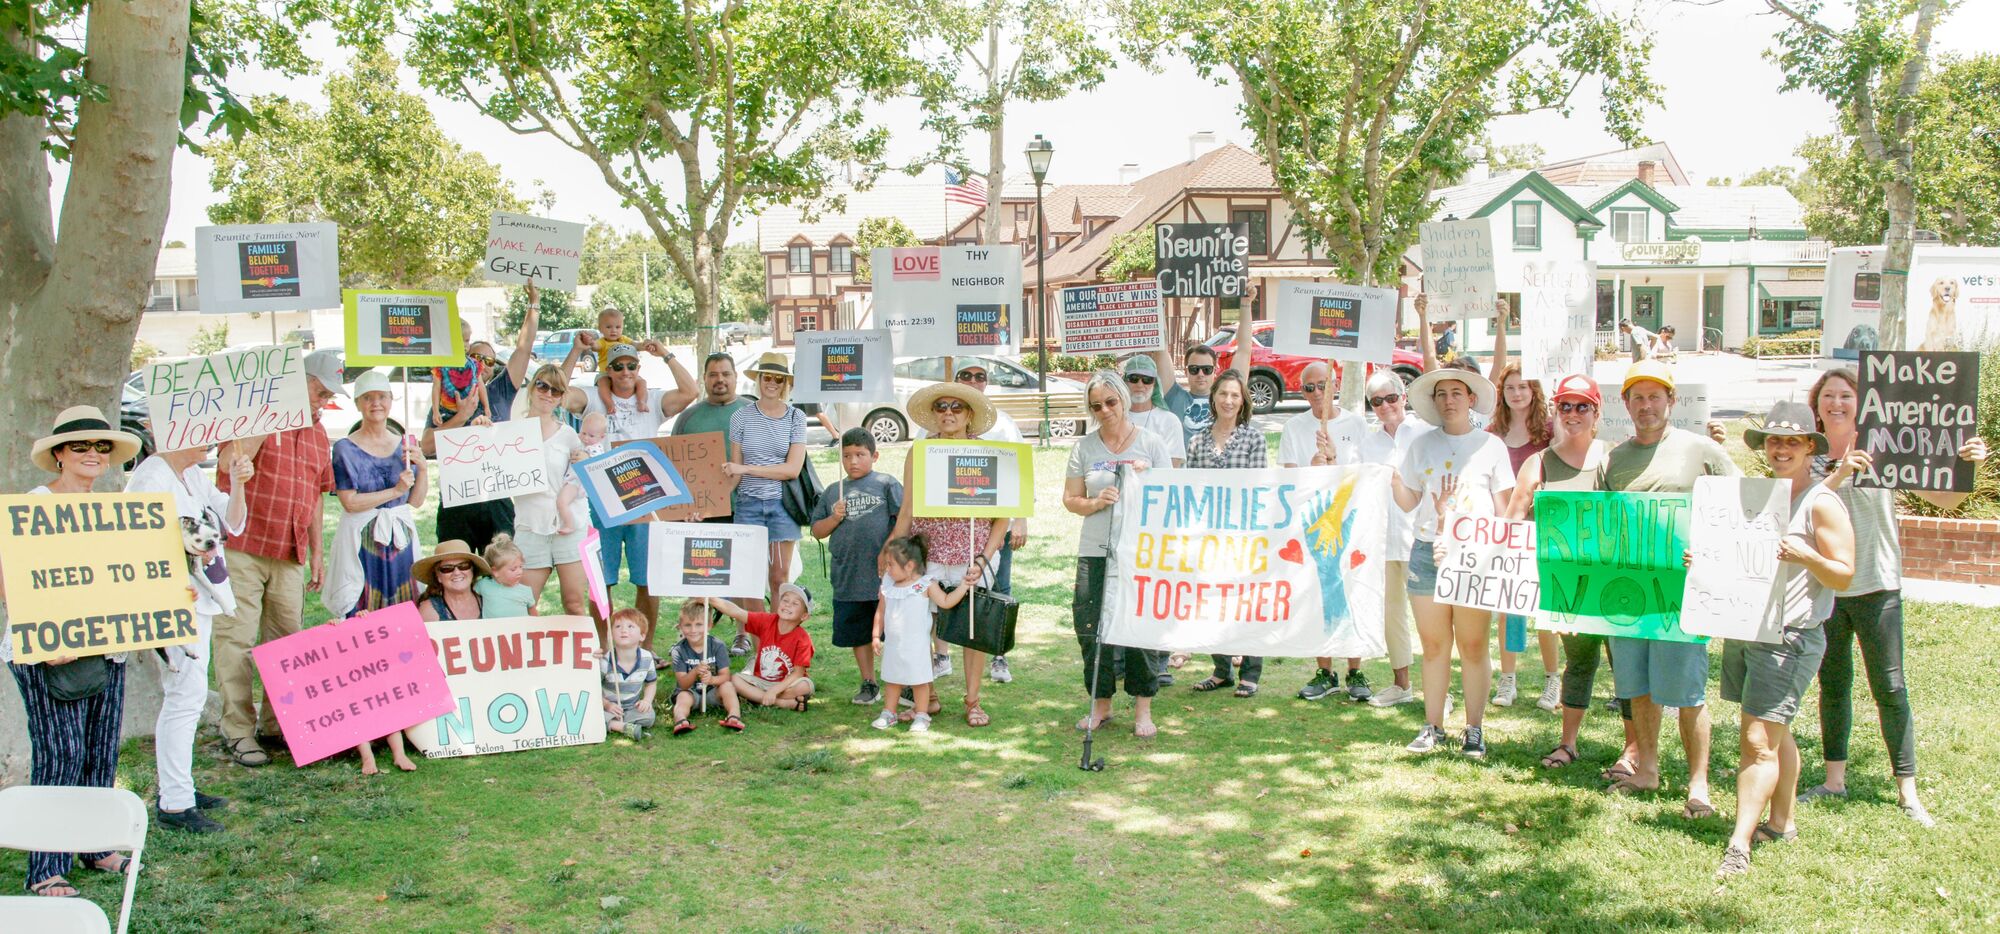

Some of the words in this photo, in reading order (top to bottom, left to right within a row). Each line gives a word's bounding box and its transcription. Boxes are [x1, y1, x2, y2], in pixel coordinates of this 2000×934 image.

[213, 232, 250, 242] Reunite
[253, 231, 293, 241] Families
[296, 230, 320, 240] Now!
[1421, 224, 1480, 242] Children
[490, 237, 528, 252] MAKE
[534, 242, 578, 258] AMERICA
[1158, 224, 1248, 258] Reunite
[248, 244, 286, 254] FAMILIES
[966, 250, 989, 260] THY
[1424, 244, 1468, 260] should
[1476, 242, 1491, 258] be
[1636, 246, 1664, 255] OLIVE
[1666, 246, 1698, 257] HOUSE
[248, 255, 278, 265] BELONG
[894, 256, 939, 272] LOVE
[1210, 257, 1244, 272] the
[250, 265, 290, 276] TOGETHER
[490, 257, 562, 282] GREAT.
[952, 276, 1005, 286] NEIGHBOR
[1157, 263, 1248, 296] Children
[1428, 280, 1456, 292] NOT
[360, 296, 392, 304] Reunite
[1066, 291, 1075, 302] IN
[1080, 290, 1096, 301] OUR
[1100, 292, 1124, 303] LOVE
[1131, 290, 1158, 300] WINS
[1294, 286, 1324, 296] Reunite
[1327, 289, 1360, 298] Families
[1362, 292, 1383, 300] Now!
[388, 307, 421, 316] FAMILIES
[1066, 301, 1096, 312] AMERICA
[1320, 299, 1352, 310] FAMILIES
[958, 311, 996, 322] FAMILIES
[1320, 308, 1344, 318] BELONG
[388, 316, 415, 326] BELONG
[885, 318, 910, 328] (Matt.
[911, 317, 935, 326] 22:39)
[958, 323, 988, 333] BELONG
[1066, 320, 1105, 328] DISABILITIES
[1122, 316, 1156, 324] RESPECTED
[1320, 317, 1352, 328] TOGETHER
[389, 326, 424, 335] TOGETHER
[959, 334, 1000, 344] TOGETHER
[1066, 341, 1100, 350] DIVERSITY
[1116, 337, 1159, 346] CELEBRATED
[828, 346, 854, 354] FAMILIES
[828, 355, 849, 364] BELONG
[150, 362, 188, 395] BE
[194, 358, 220, 389] A
[226, 345, 300, 382] VOICE
[828, 364, 856, 372] TOGETHER
[1866, 354, 1956, 384] Make
[169, 387, 224, 420] FOR
[234, 376, 284, 408] THE
[1858, 388, 1975, 426] America
[166, 404, 304, 450] Voiceless
[443, 434, 538, 466] Love
[962, 447, 996, 455] Families
[481, 462, 504, 476] thy
[612, 460, 640, 476] FAMILIES
[956, 458, 988, 467] FAMILIES
[616, 468, 641, 484] BELONG
[956, 467, 982, 476] BELONG
[1855, 459, 1952, 489] Again
[448, 468, 544, 500] NEIGHBOR
[620, 474, 652, 492] TOGETHER
[956, 476, 990, 486] TOGETHER
[847, 496, 880, 507] STRAUSS
[1140, 484, 1296, 531] FAMILIES
[8, 502, 166, 536] FAMILIES
[1453, 516, 1536, 550] CRUEL
[1536, 496, 1687, 571] REUNIT
[692, 540, 723, 548] FAMILIES
[691, 549, 716, 558] BELONG
[1136, 532, 1269, 574] BELONG
[1460, 544, 1476, 568] is
[1491, 552, 1529, 575] not
[1736, 539, 1779, 576] NOT
[690, 558, 724, 566] TOGETHER
[31, 566, 94, 590] NEED
[107, 563, 136, 582] TO
[145, 560, 172, 580] BE
[1438, 567, 1540, 612] STRENGT
[1134, 575, 1292, 622] TOGETHER
[1552, 573, 1684, 634] NOW
[12, 608, 197, 654] TOGETHER
[280, 626, 389, 673] FAMILIES
[304, 659, 389, 700] BELONG
[306, 682, 420, 732] TOGETHER
[436, 688, 590, 746] NOW
[422, 746, 463, 758] Families
[474, 743, 504, 754] Belong
